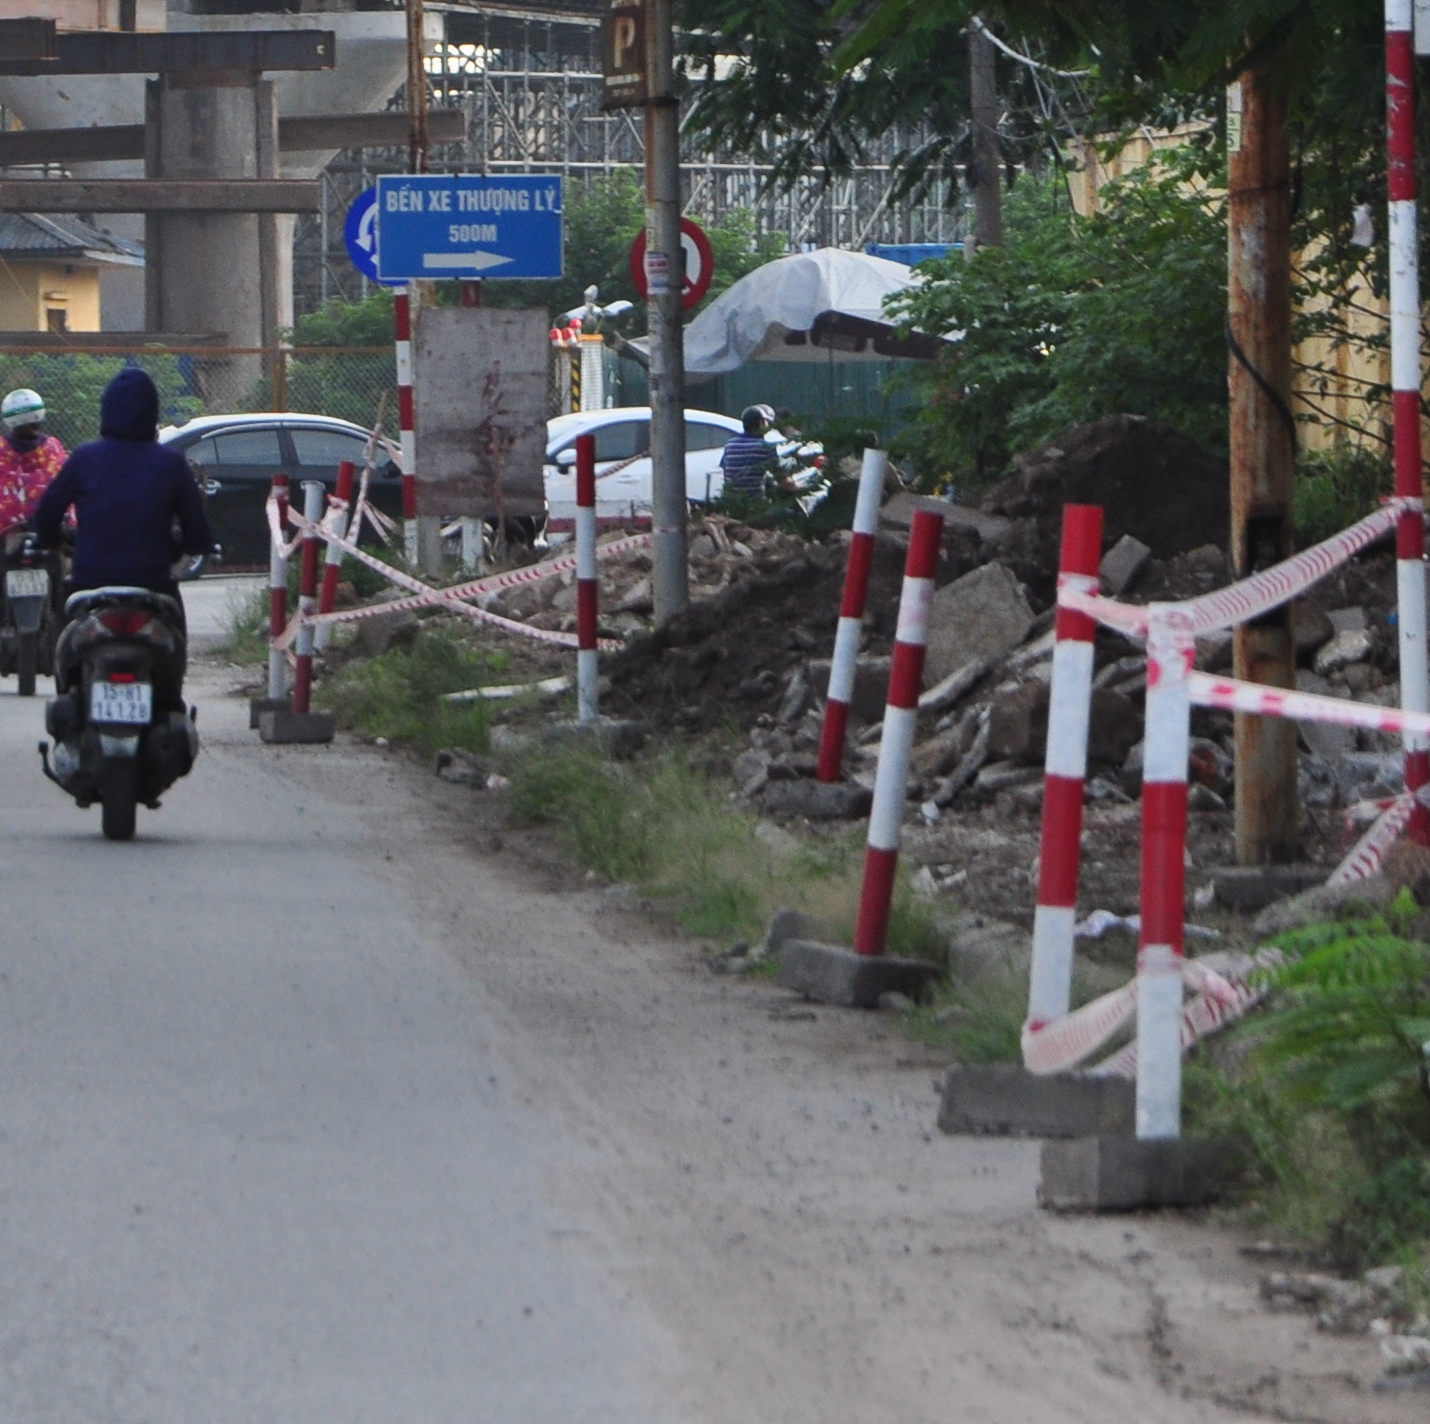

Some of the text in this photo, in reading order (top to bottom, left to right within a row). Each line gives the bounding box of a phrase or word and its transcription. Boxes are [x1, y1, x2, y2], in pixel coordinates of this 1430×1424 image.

[614, 16, 637, 68] P
[386, 184, 556, 216] BẾN XE THƯỢNG LÝ
[448, 224, 498, 243] 500M
